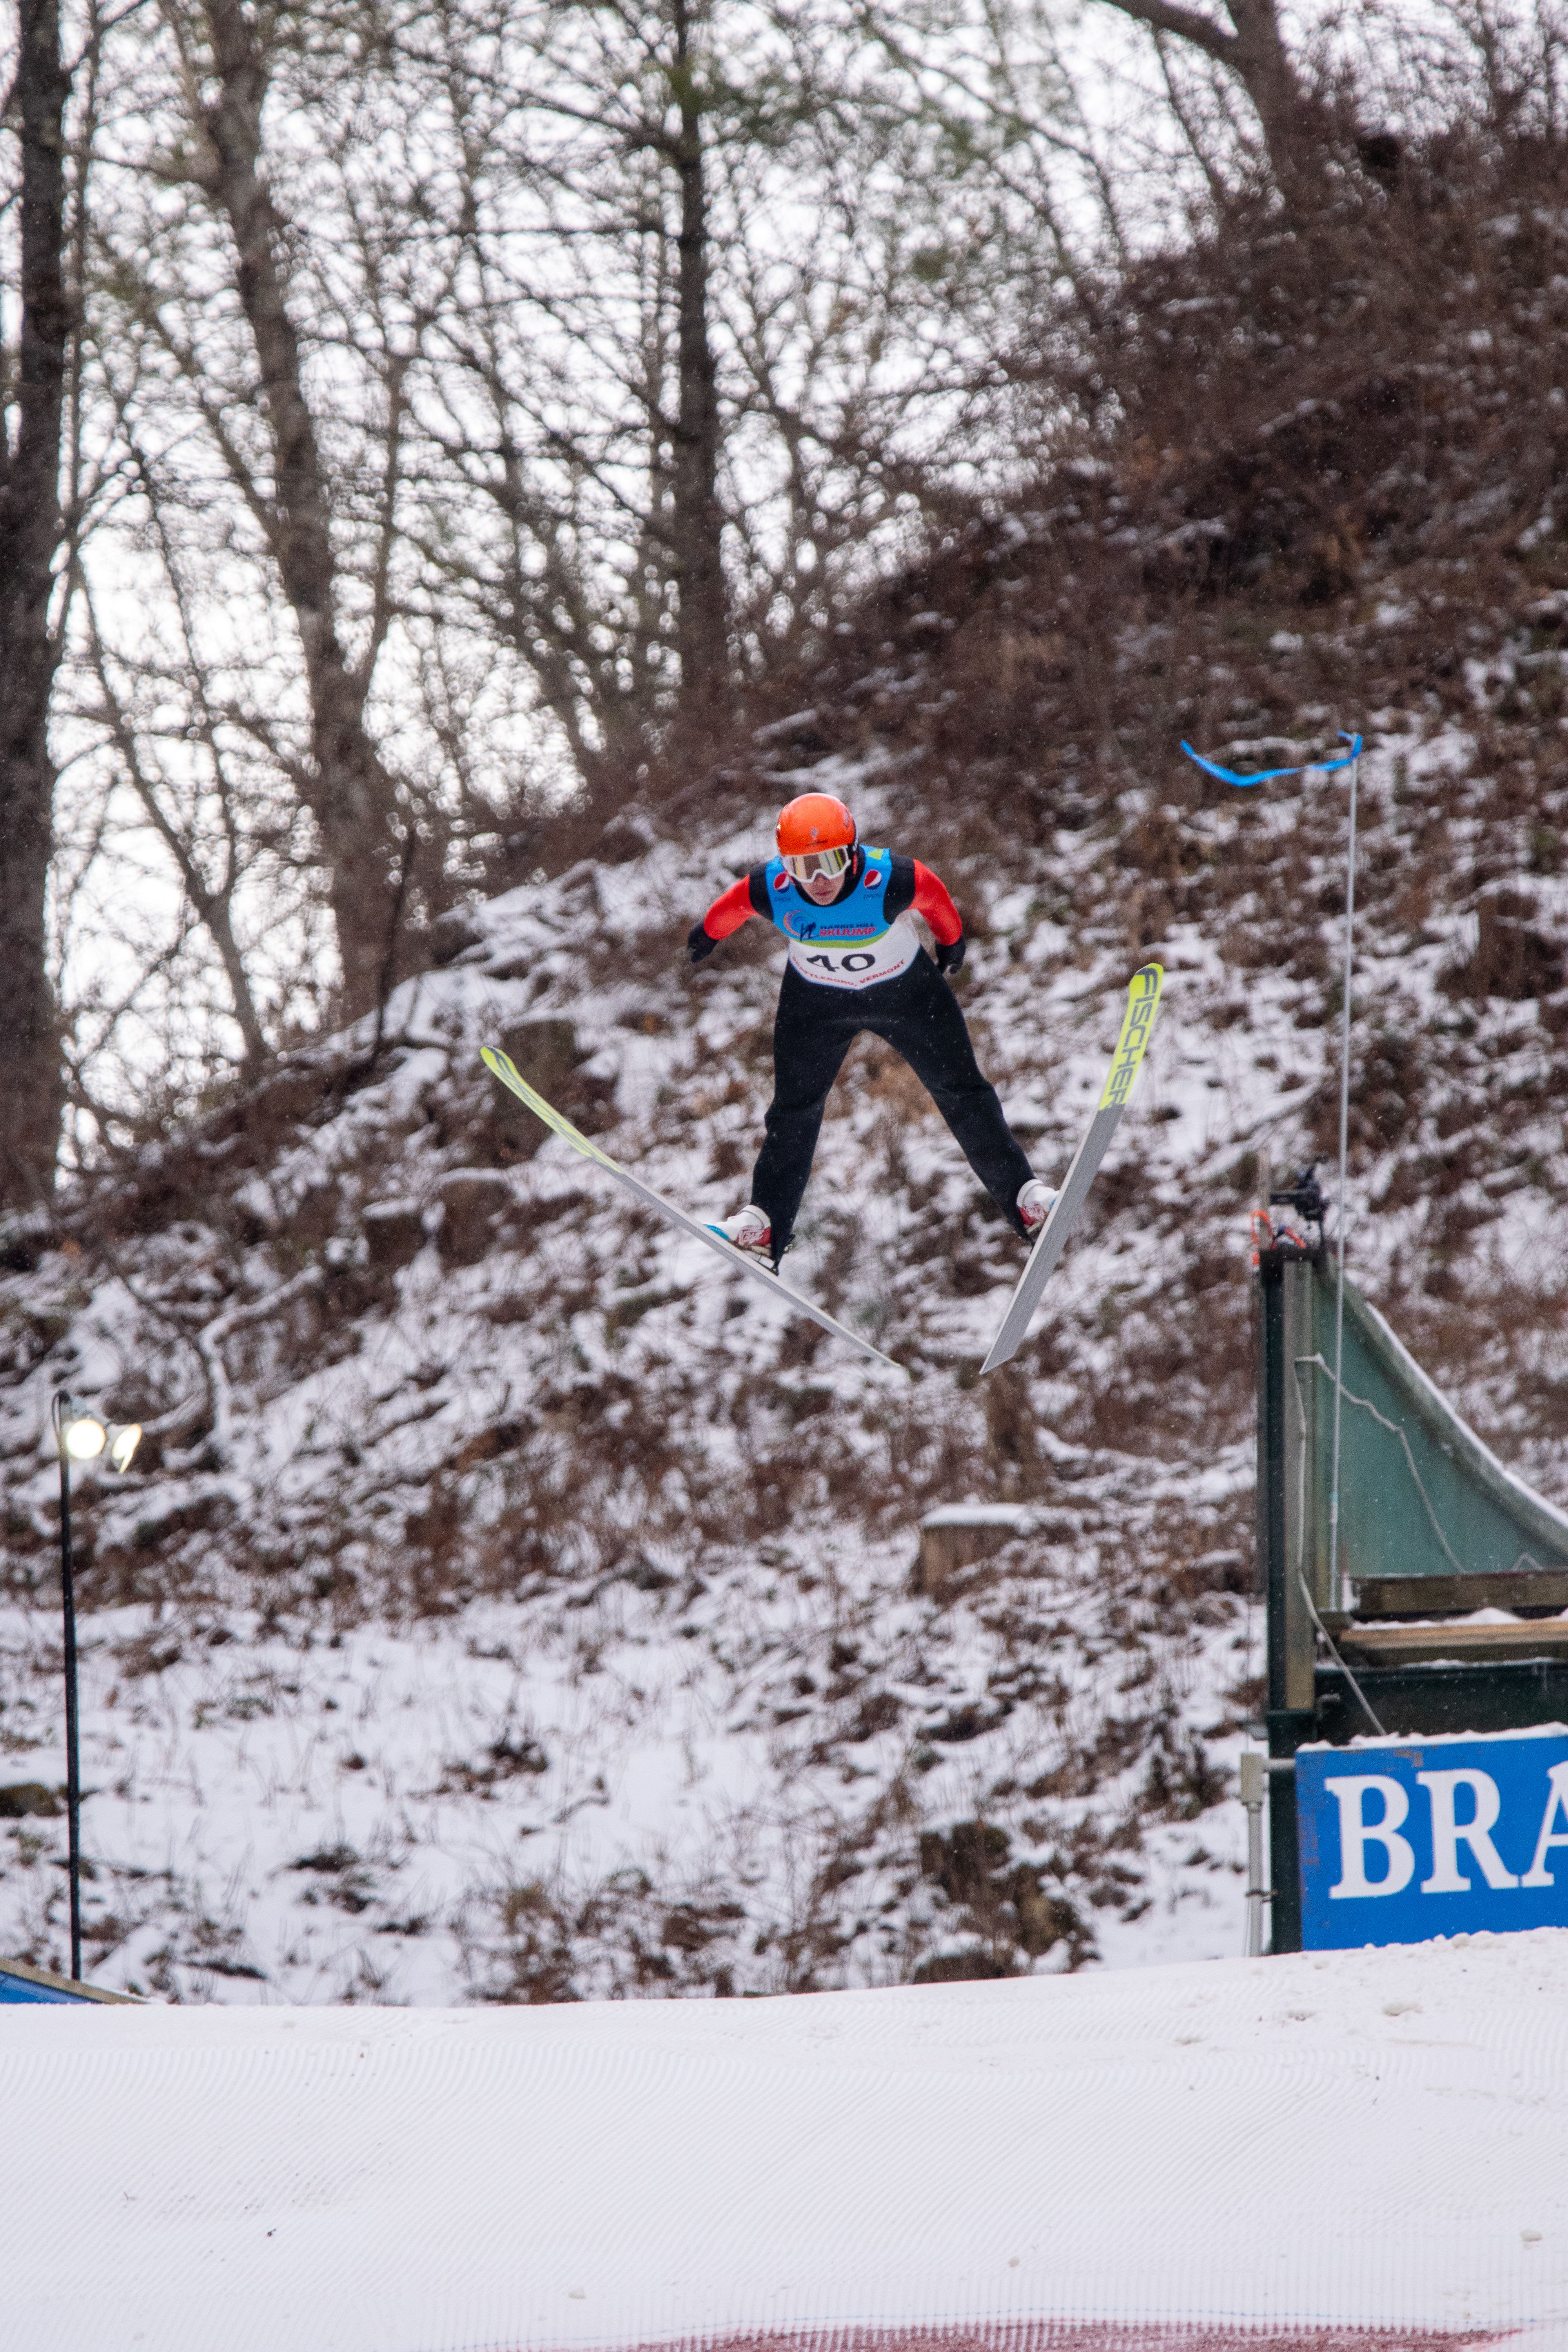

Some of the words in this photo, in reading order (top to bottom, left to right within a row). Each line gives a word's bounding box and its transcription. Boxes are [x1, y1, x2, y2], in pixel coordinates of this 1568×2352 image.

[806, 953, 875, 972] 40
[860, 959, 904, 983] VERMONT
[1109, 967, 1158, 1105] FISCHER
